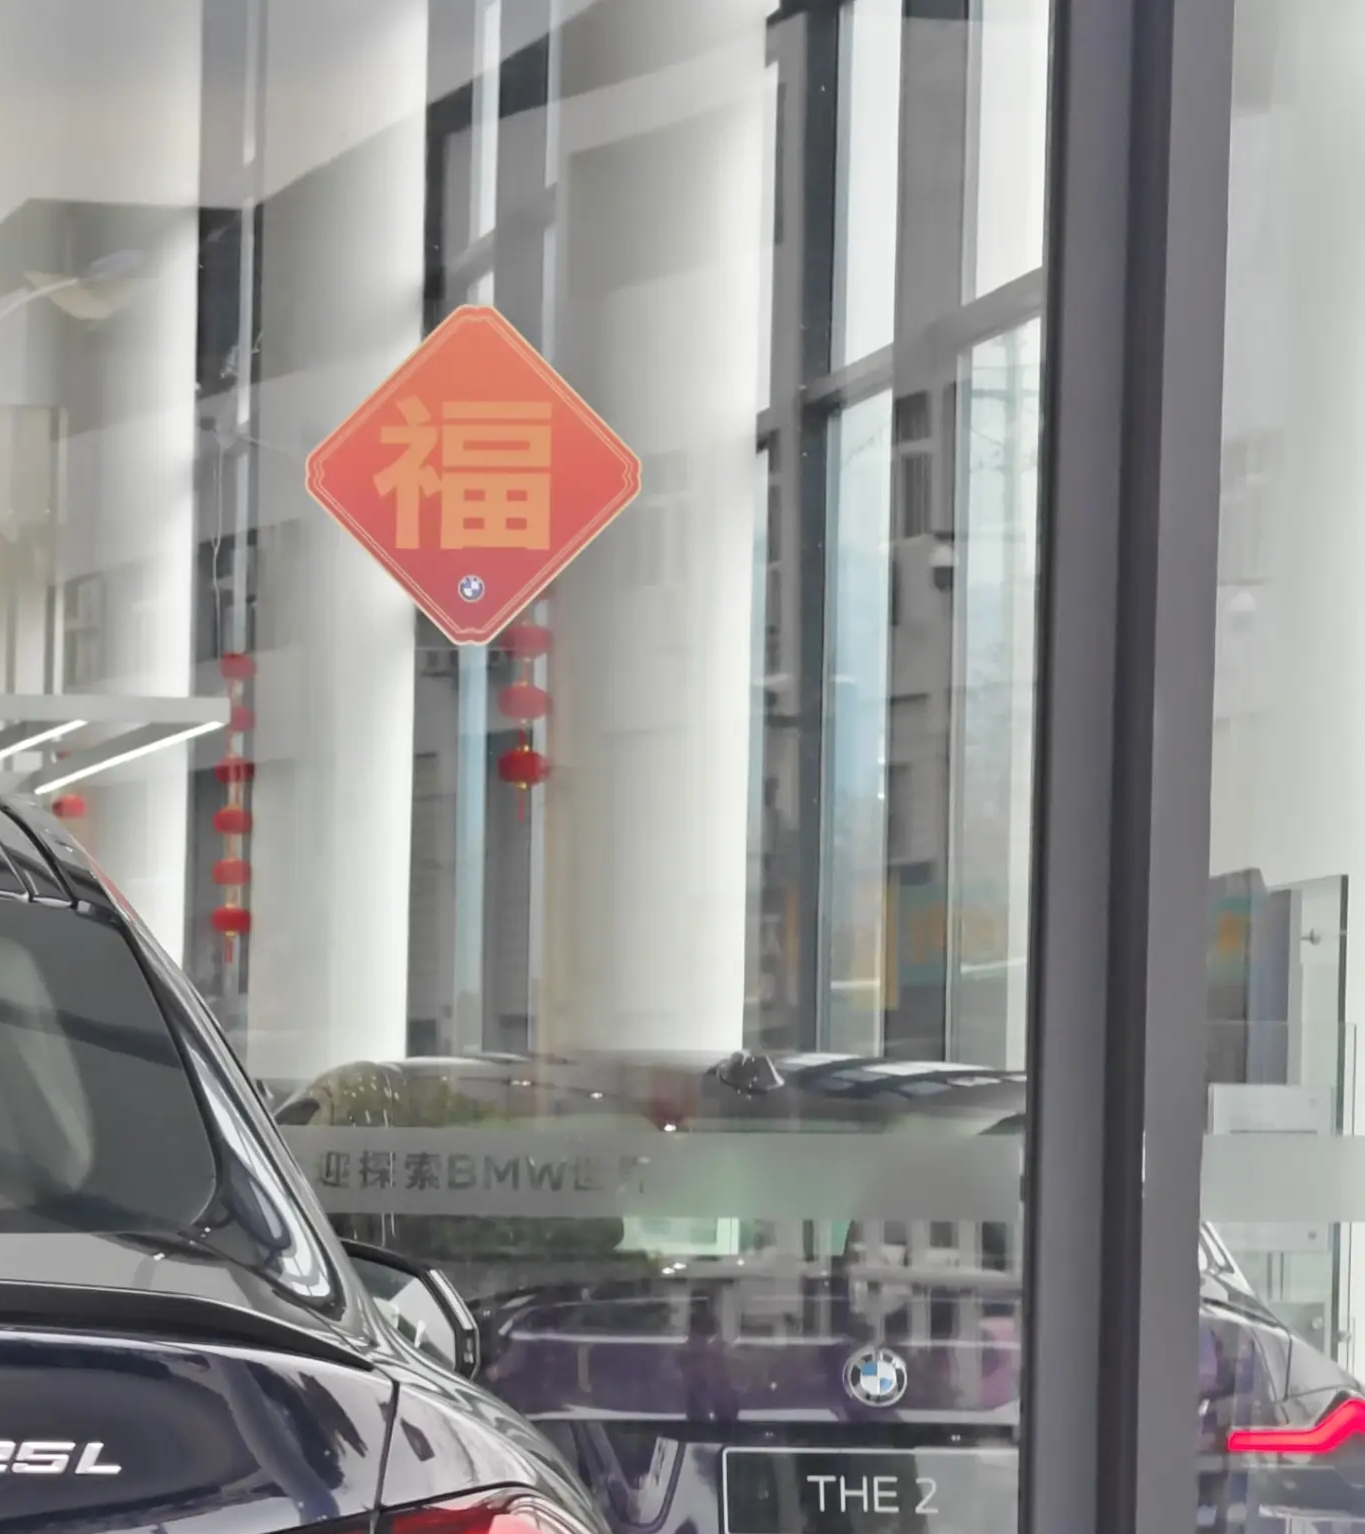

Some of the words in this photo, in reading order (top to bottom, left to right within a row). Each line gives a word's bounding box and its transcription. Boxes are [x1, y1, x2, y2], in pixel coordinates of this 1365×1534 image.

[373, 395, 552, 551] 福
[806, 1475, 900, 1513] THE
[914, 1477, 940, 1514] 2
